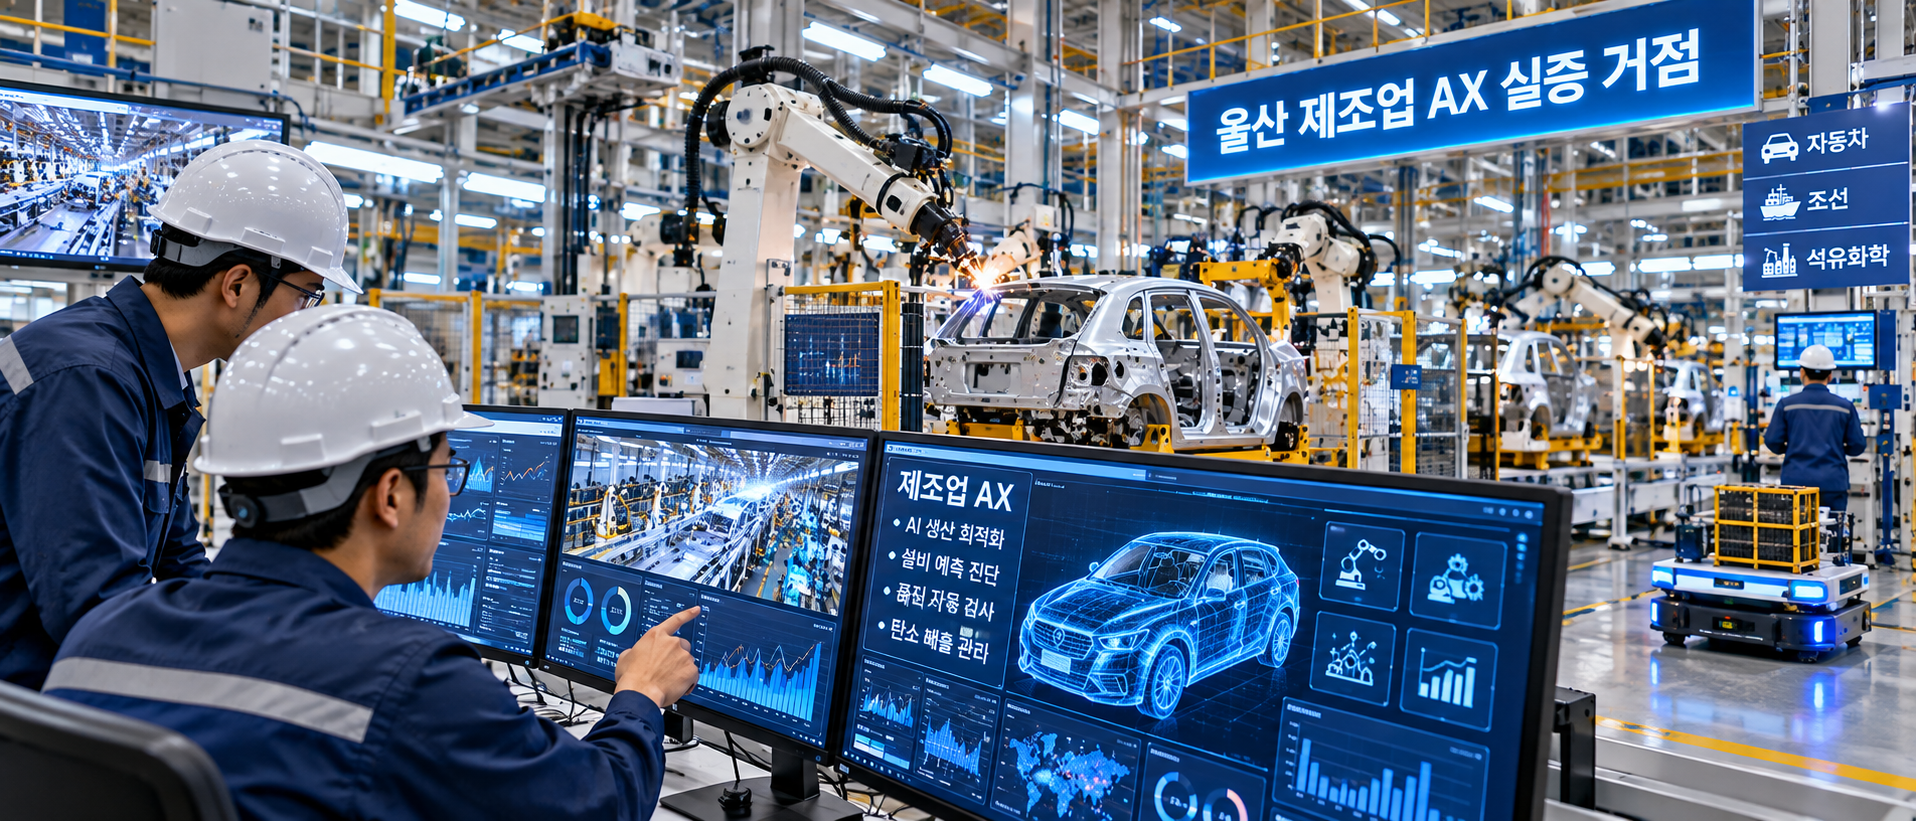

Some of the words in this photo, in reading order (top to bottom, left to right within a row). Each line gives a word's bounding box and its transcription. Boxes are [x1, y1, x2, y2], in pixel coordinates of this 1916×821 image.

[1217, 101, 1288, 154] 울산
[1298, 78, 1413, 138] 제조업
[1428, 70, 1488, 119] AX
[1501, 50, 1588, 111] 실증
[1603, 28, 1698, 91] 거점
[1807, 128, 1869, 154] 자동차
[1808, 187, 1848, 210] 조선
[1807, 244, 1890, 270] 석유화학
[898, 470, 968, 507] 제조업
[974, 481, 1014, 511] AX
[906, 517, 921, 534] AI
[926, 519, 955, 541] 생산
[902, 548, 930, 572] 설비
[936, 556, 963, 579] 예측
[969, 562, 999, 586] 진단
[891, 619, 918, 643] 탄소
